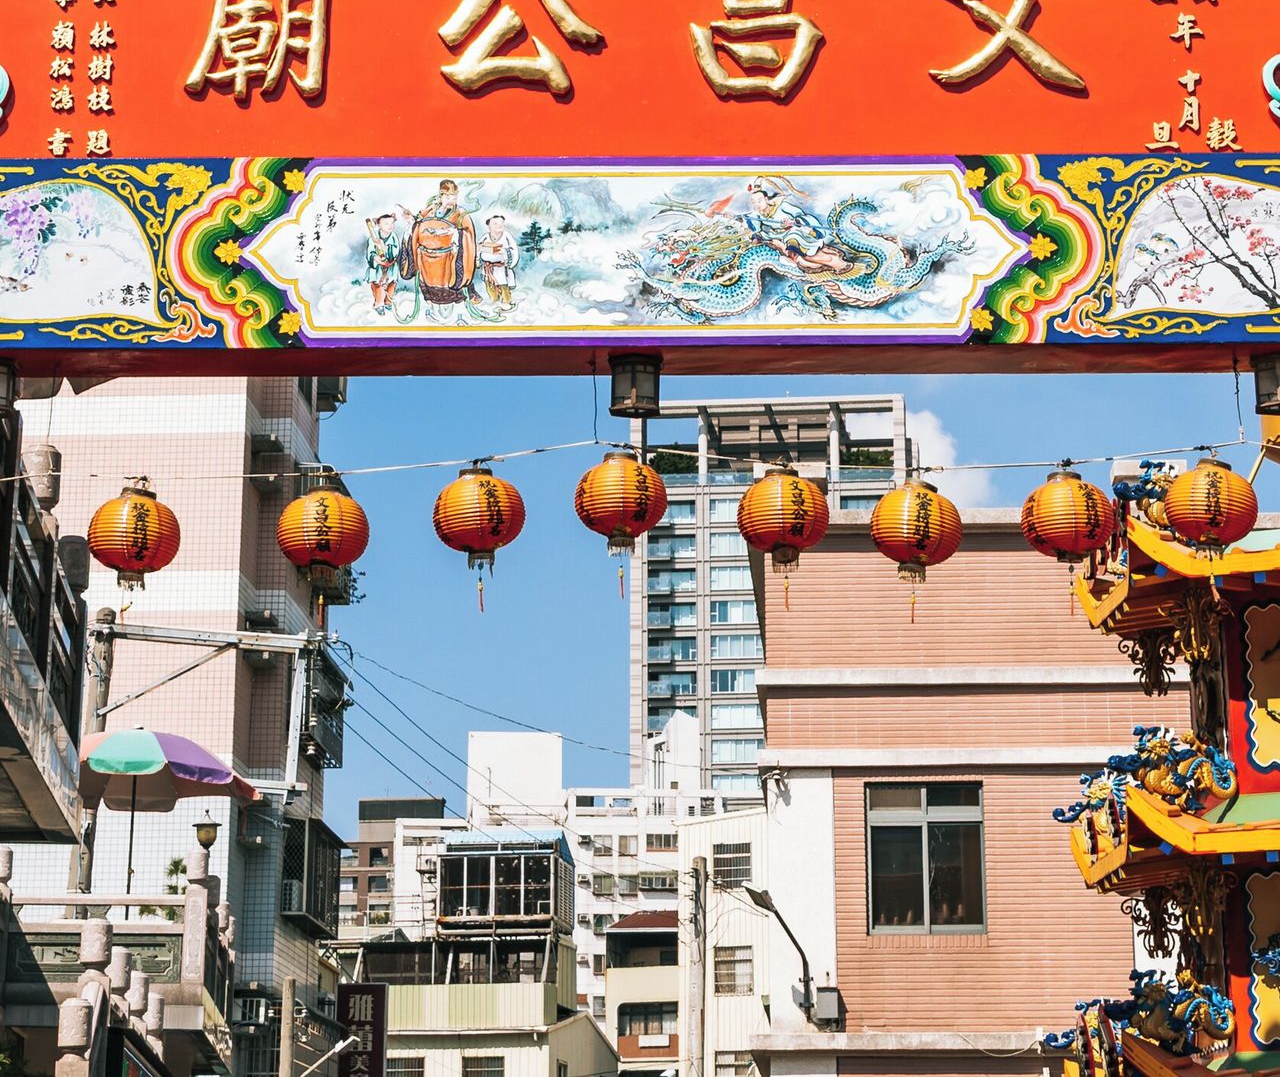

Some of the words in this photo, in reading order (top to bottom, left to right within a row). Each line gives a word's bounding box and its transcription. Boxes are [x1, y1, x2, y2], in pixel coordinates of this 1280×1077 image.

[48, 128, 72, 156] 書
[86, 130, 111, 155] 題
[313, 496, 333, 553] 文昌公廟
